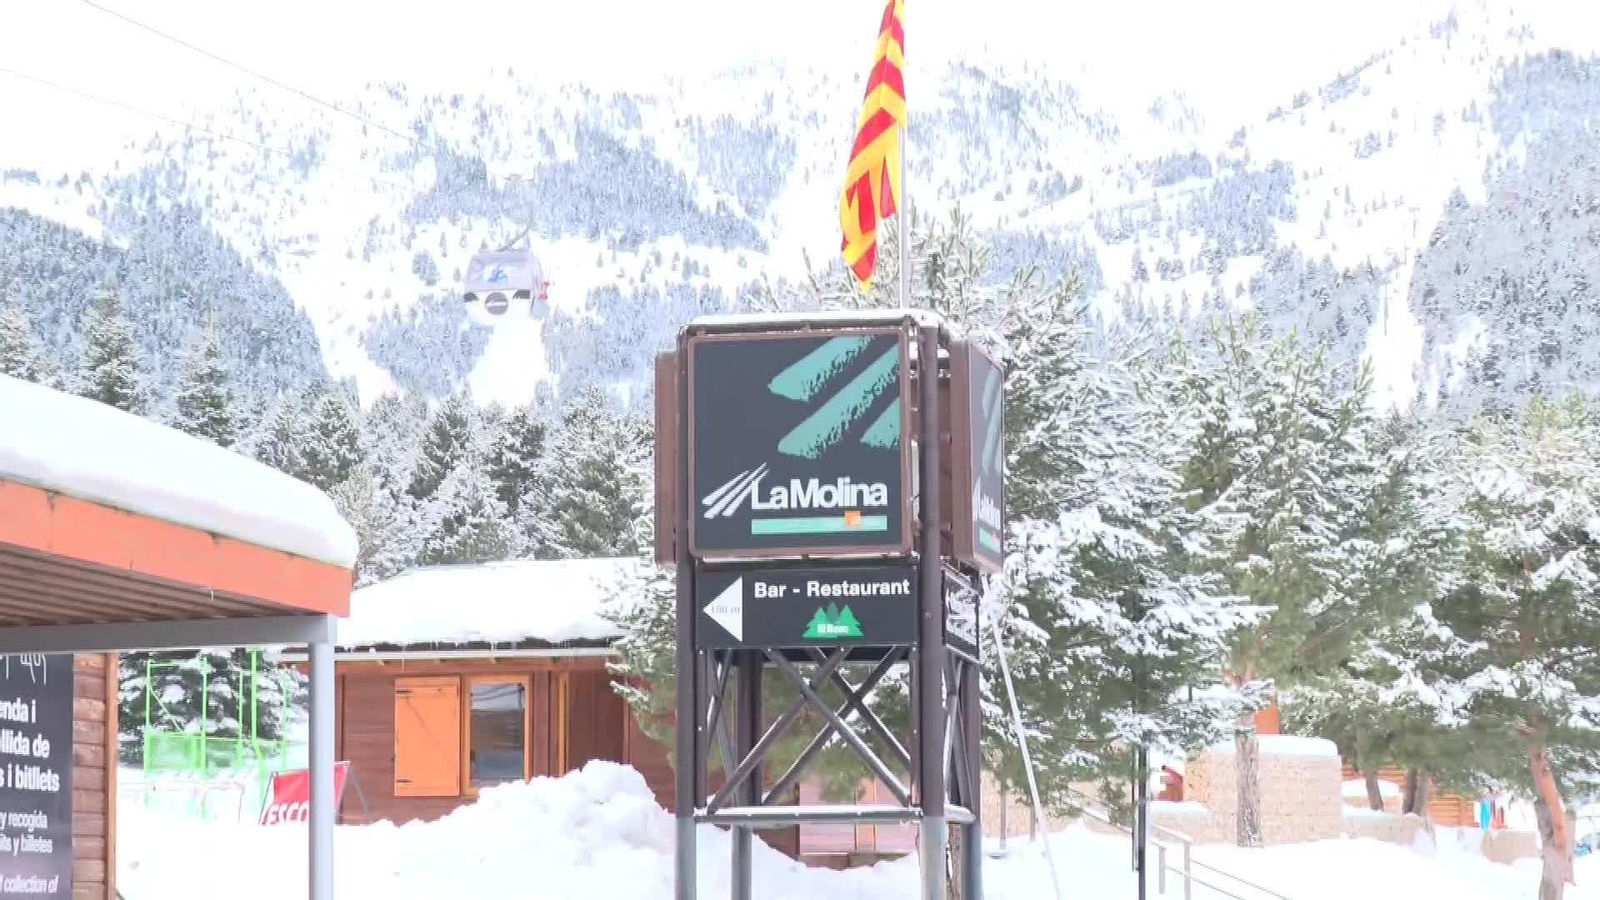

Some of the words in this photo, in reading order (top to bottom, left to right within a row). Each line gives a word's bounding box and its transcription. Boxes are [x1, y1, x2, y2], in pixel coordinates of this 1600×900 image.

[754, 581, 787, 598] Bar
[807, 578, 910, 597] Restaurant
[31, 699, 36, 724] i
[33, 733, 51, 758] de
[8, 764, 12, 788] i
[15, 763, 60, 792] bitllets
[8, 810, 48, 833] recogida
[13, 837, 20, 857] y
[21, 833, 53, 853] billetes
[4, 874, 48, 894] collection
[48, 874, 60, 894] of
